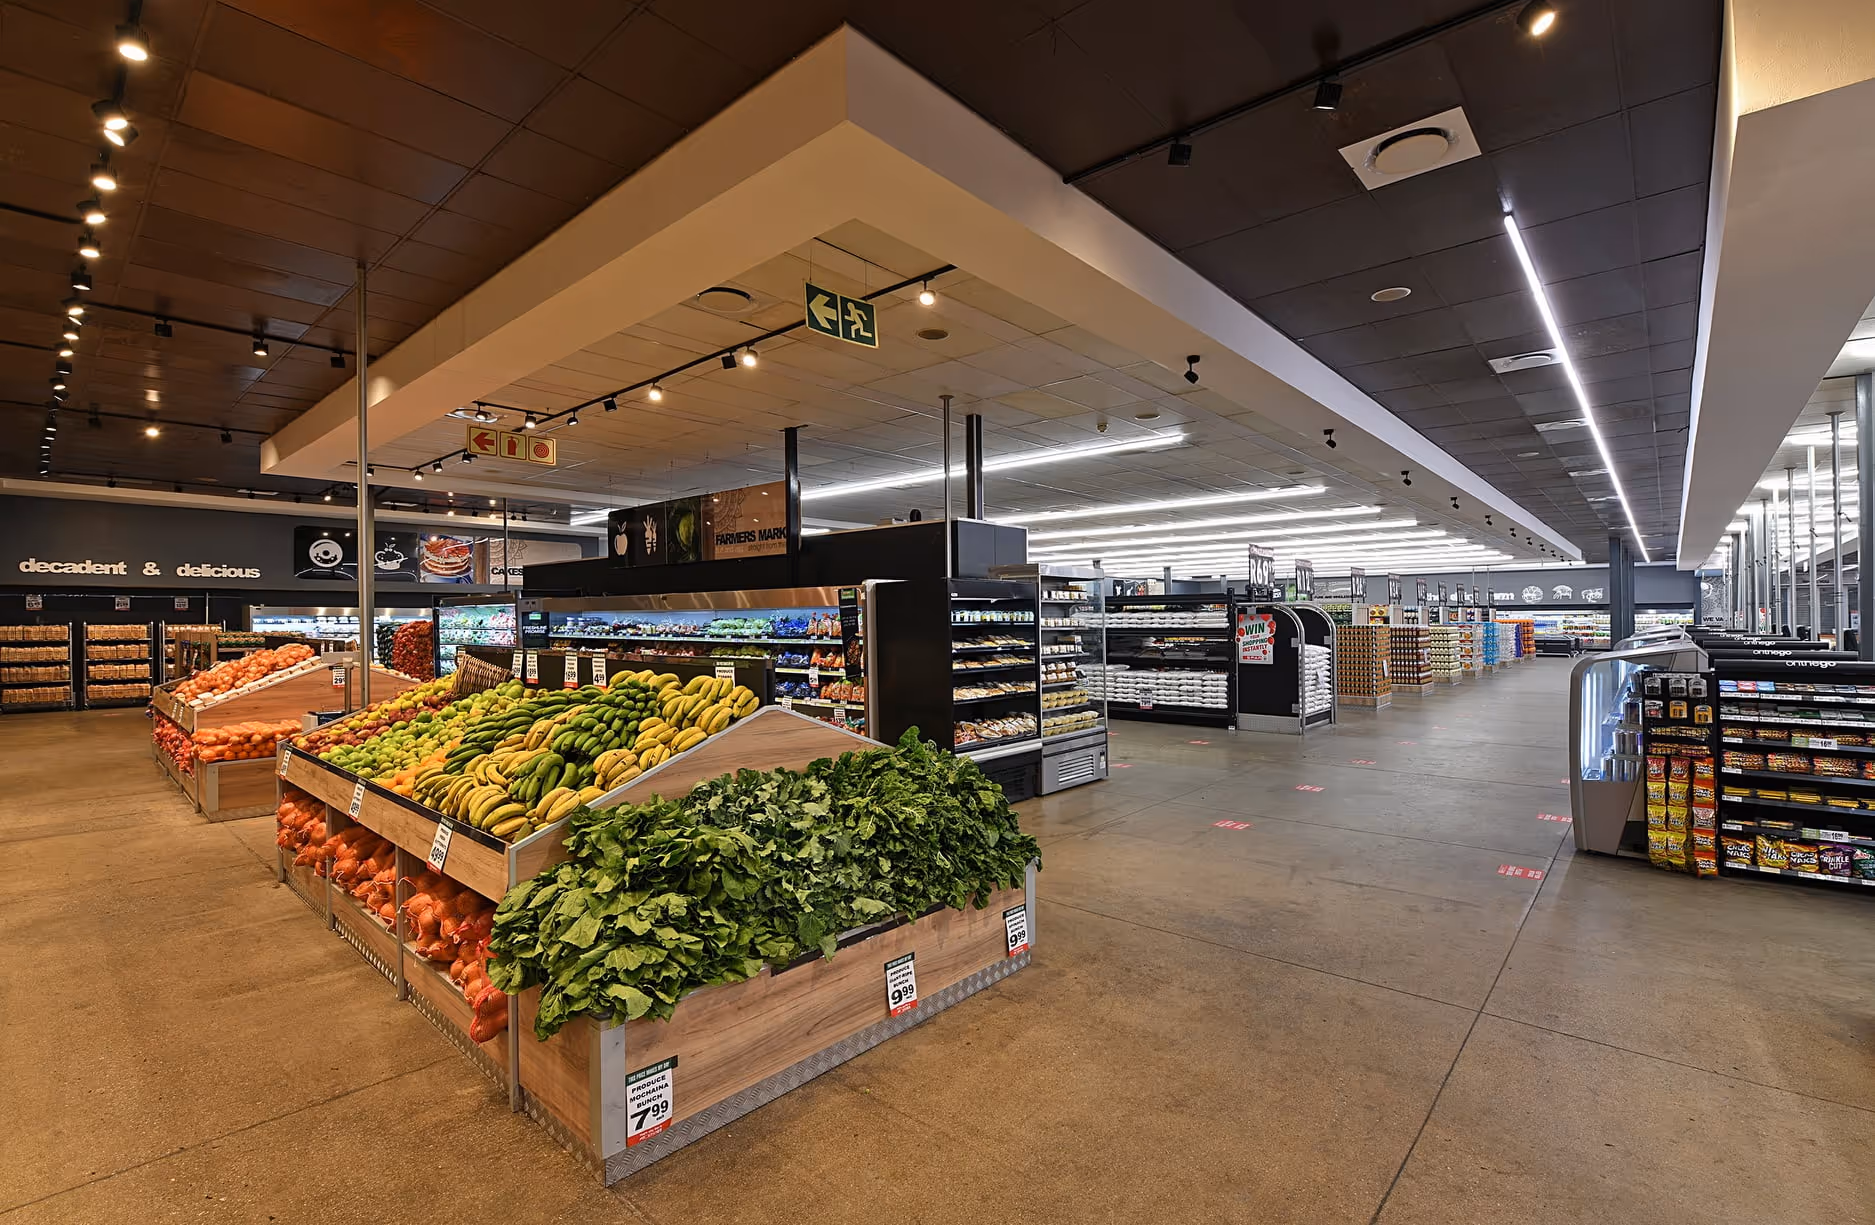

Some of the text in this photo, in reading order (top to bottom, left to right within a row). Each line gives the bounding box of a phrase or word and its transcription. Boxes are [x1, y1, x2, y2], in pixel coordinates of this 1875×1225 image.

[715, 527, 786, 546] FARMERS MARK
[19, 558, 261, 578] decadent & delicious
[1245, 622, 1265, 636] WIN
[1242, 637, 1268, 647] SHOPPING
[1242, 643, 1268, 652] INSTANTLY
[1828, 862, 1843, 870] CUT
[891, 965, 910, 977] PRODUCE
[893, 979, 909, 988] BUNCH
[631, 1074, 666, 1094] PRODUCE
[629, 1082, 669, 1103] MOCHAINA
[637, 1093, 663, 1109] BUNCH
